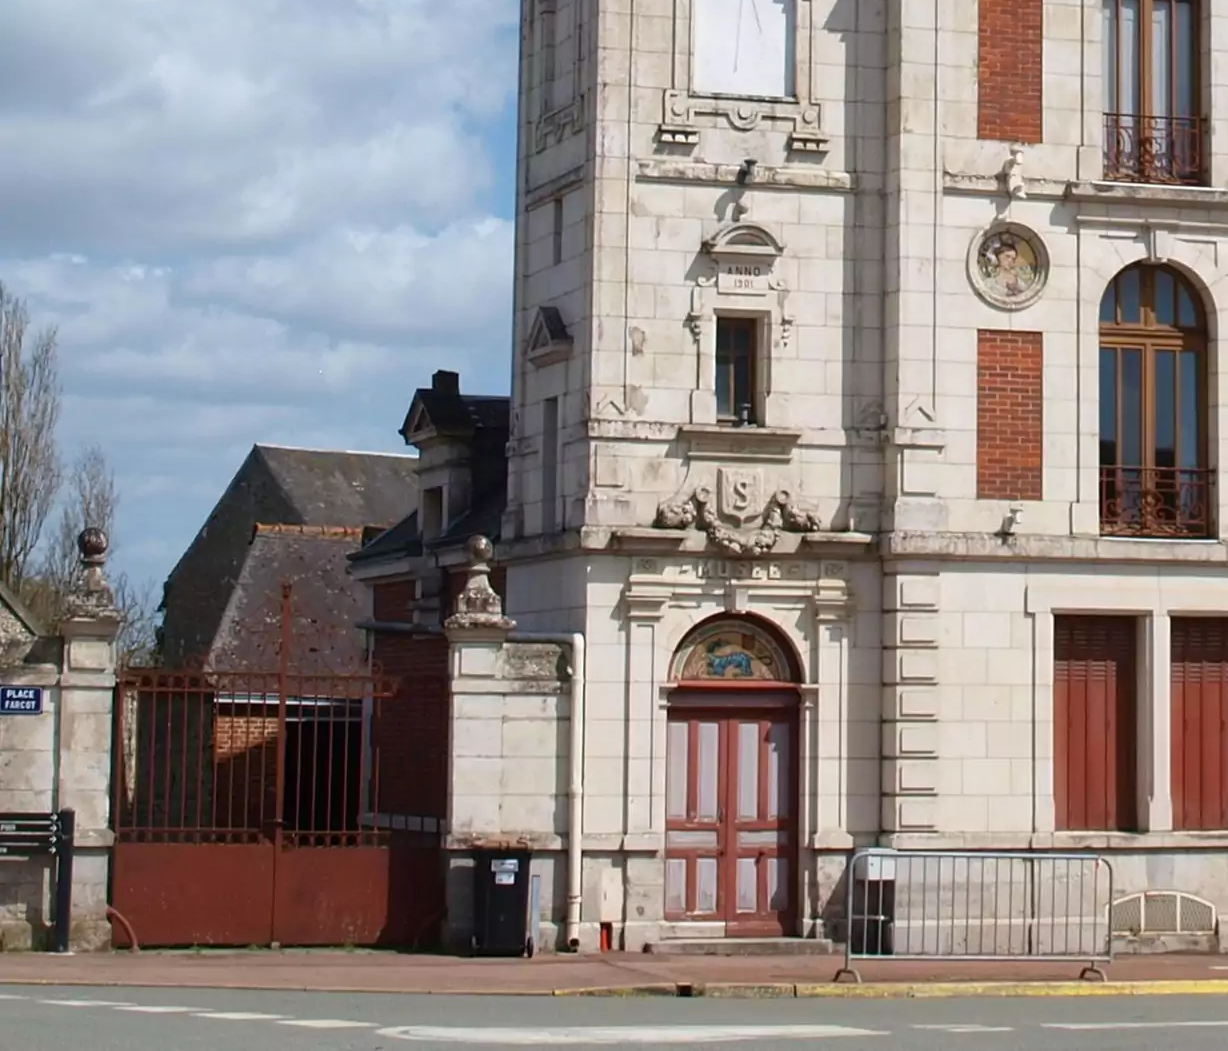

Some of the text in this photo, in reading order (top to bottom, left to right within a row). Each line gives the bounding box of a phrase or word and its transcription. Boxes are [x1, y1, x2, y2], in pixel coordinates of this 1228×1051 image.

[727, 265, 761, 276] ANNO
[6, 689, 34, 699] PLACE
[4, 700, 36, 710] FARCOT
